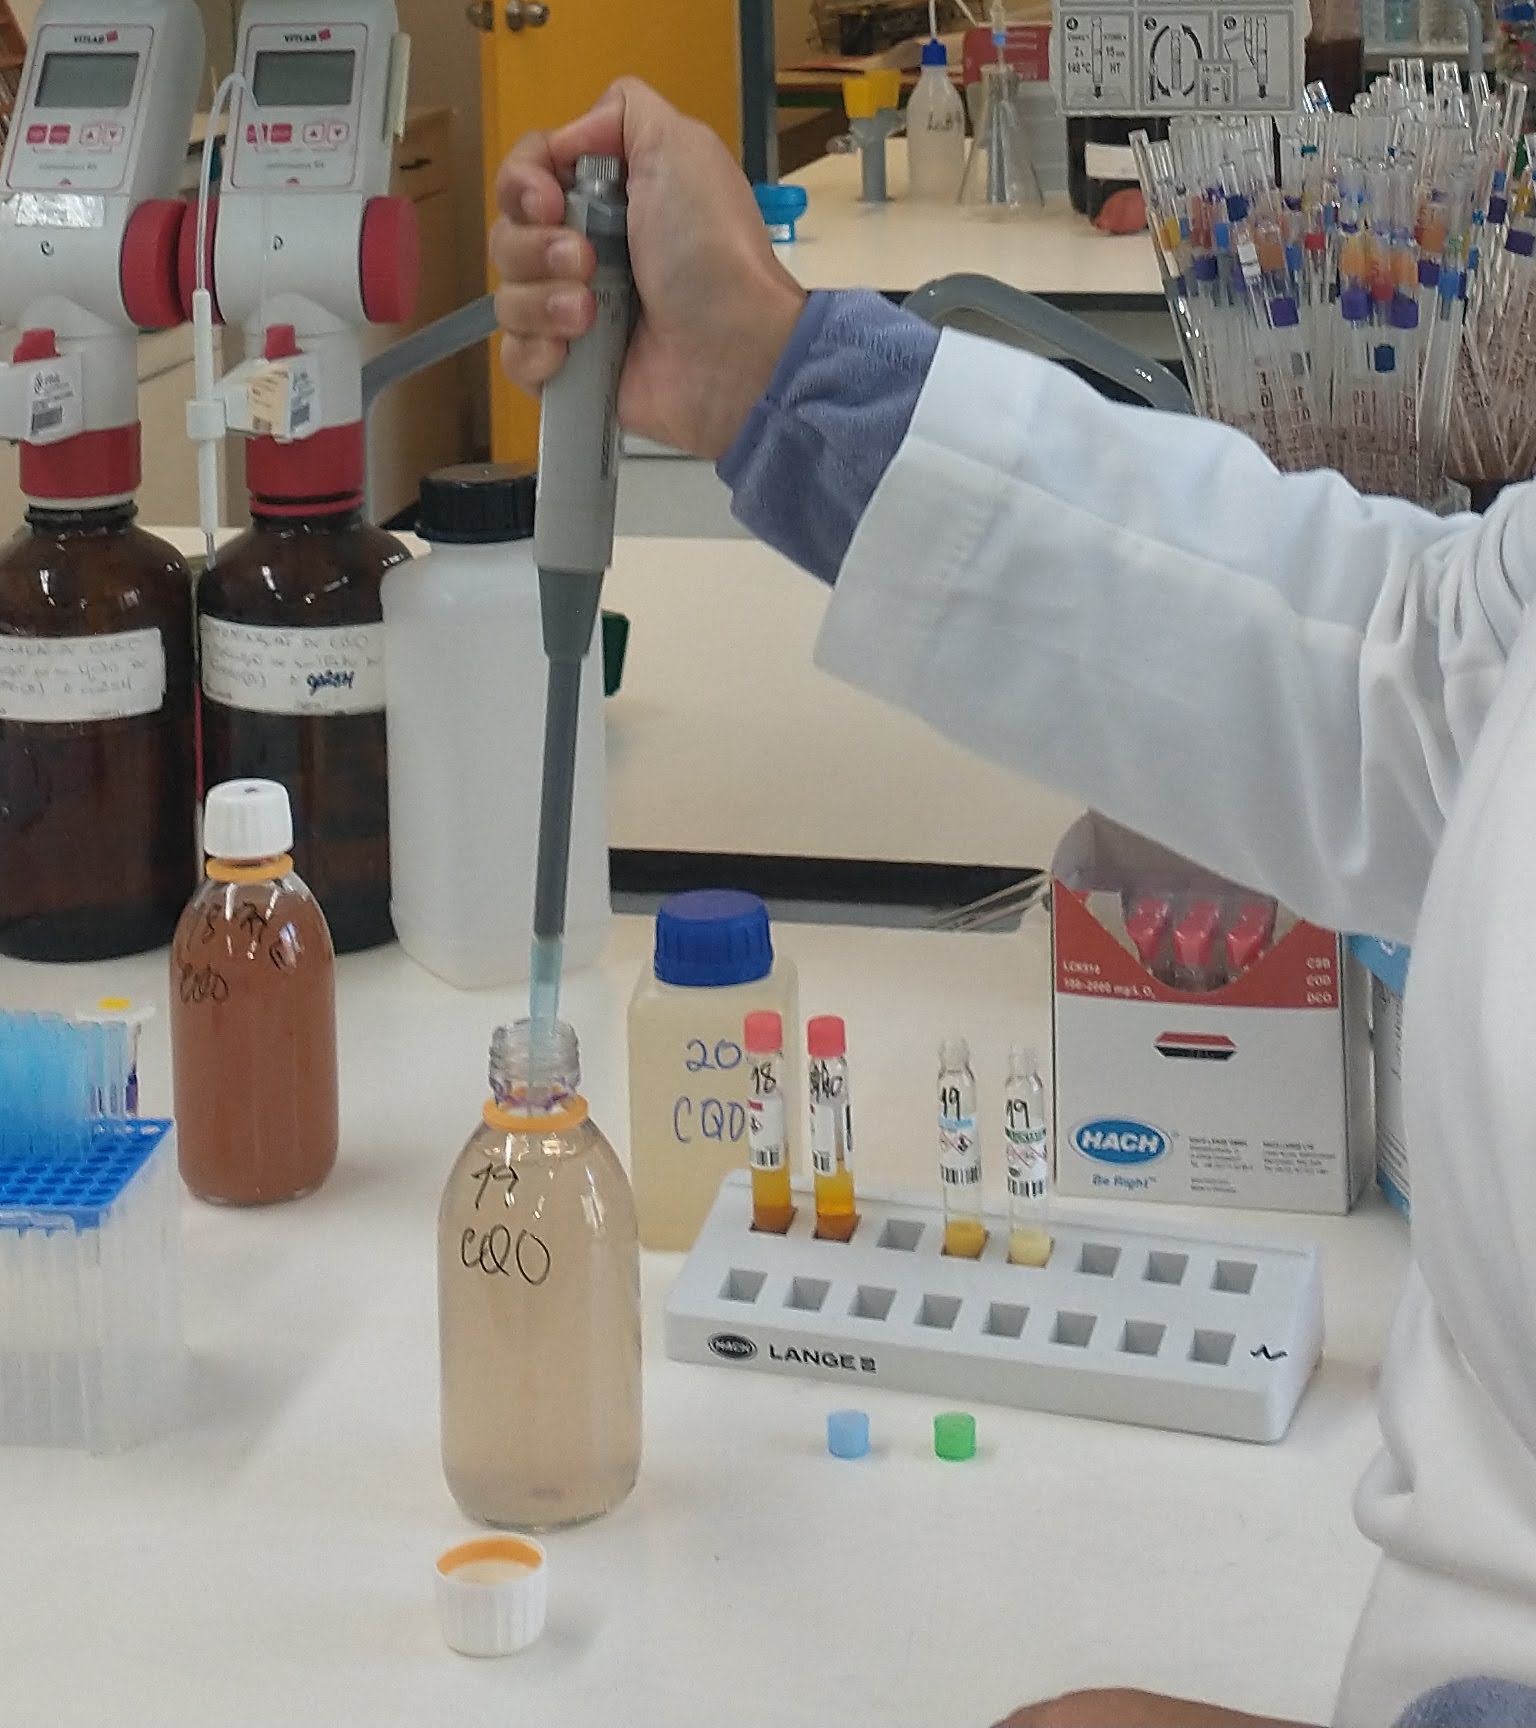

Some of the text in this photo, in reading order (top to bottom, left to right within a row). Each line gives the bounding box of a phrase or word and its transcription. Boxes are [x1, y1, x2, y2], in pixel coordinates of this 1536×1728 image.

[1305, 957, 1331, 970] CSB
[1306, 974, 1332, 987] COD
[1306, 991, 1333, 1004] DCO
[686, 1039, 743, 1072] 20
[750, 1062, 777, 1095] 18
[941, 1086, 961, 1121] 19
[1006, 1098, 1030, 1129] 19
[1080, 1129, 1158, 1153] HACH
[1092, 1174, 1108, 1186] Be
[769, 1343, 857, 1371] LANGE
